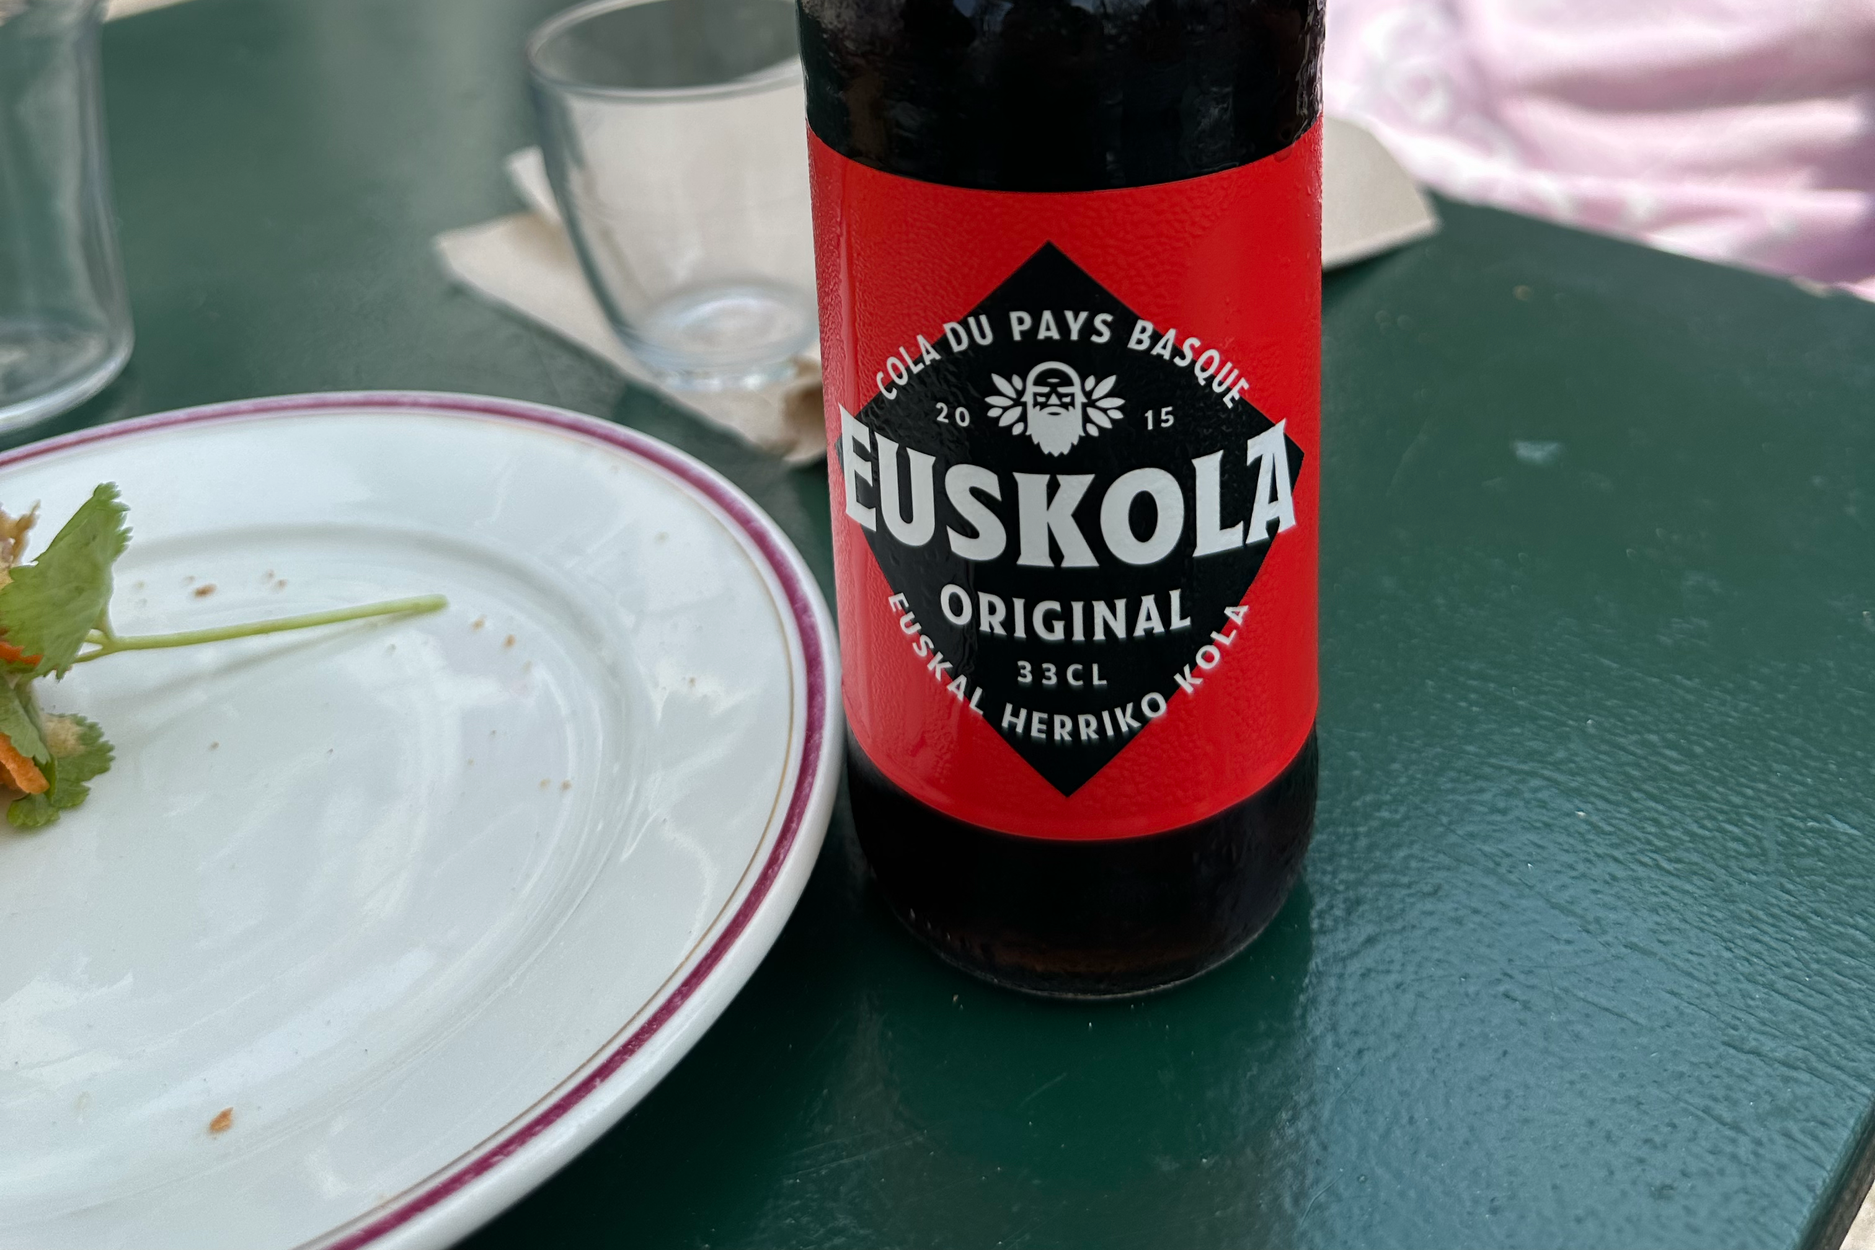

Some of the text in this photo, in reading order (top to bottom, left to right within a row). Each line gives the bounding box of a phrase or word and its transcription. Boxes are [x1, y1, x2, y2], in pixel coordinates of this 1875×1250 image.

[876, 310, 1250, 409] COLA DU PAYS BASQUE
[935, 402, 1175, 431] 20 15
[837, 401, 1297, 568] EUSKOLA
[940, 583, 1191, 641] ORIGINAL
[887, 592, 1249, 741] EUSKAL HERRIKO KOLA
[1017, 660, 1107, 686] 33CL
